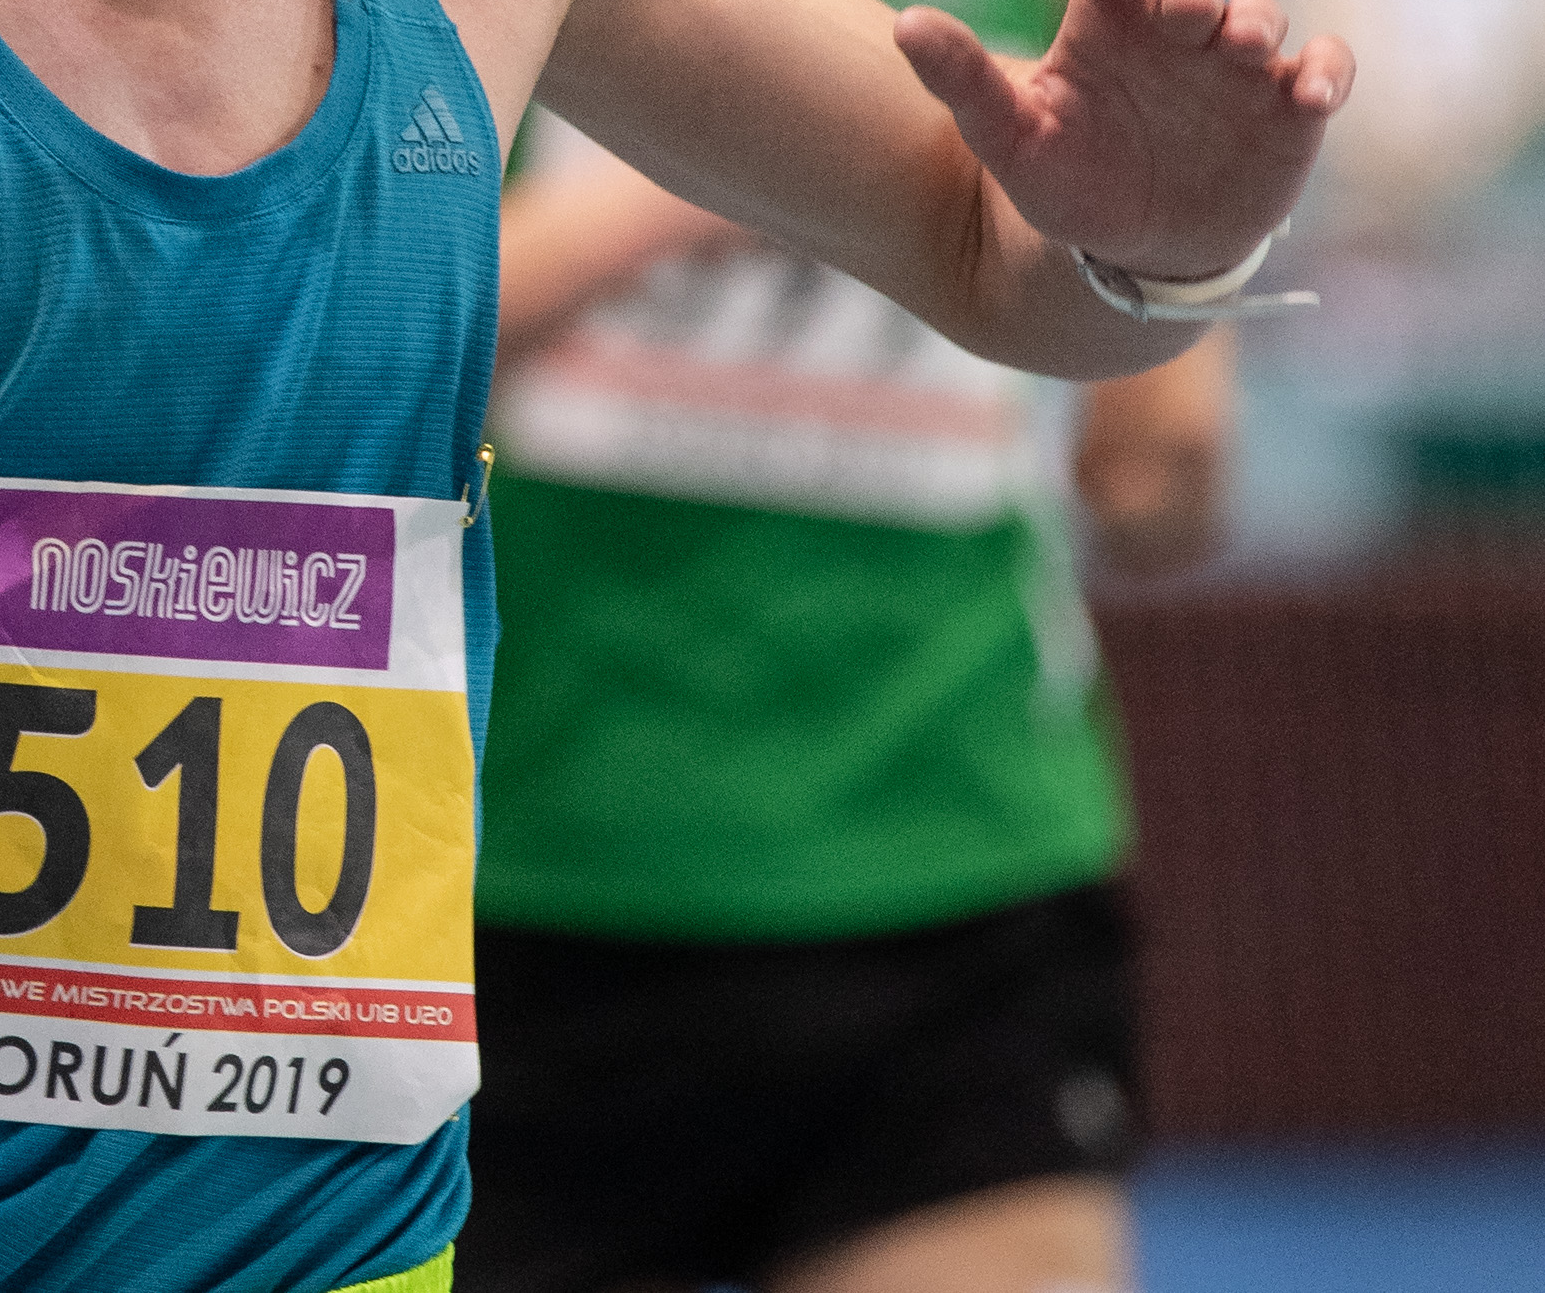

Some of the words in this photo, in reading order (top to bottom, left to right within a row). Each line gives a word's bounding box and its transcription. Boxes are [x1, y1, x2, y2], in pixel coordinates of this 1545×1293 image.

[392, 142, 480, 176] adidas
[51, 983, 258, 1018] MISTRZOSTWA
[263, 998, 351, 1022] POLSKI
[356, 1002, 400, 1024] U18
[404, 1004, 454, 1027] U20
[206, 1053, 350, 1117] 2019
